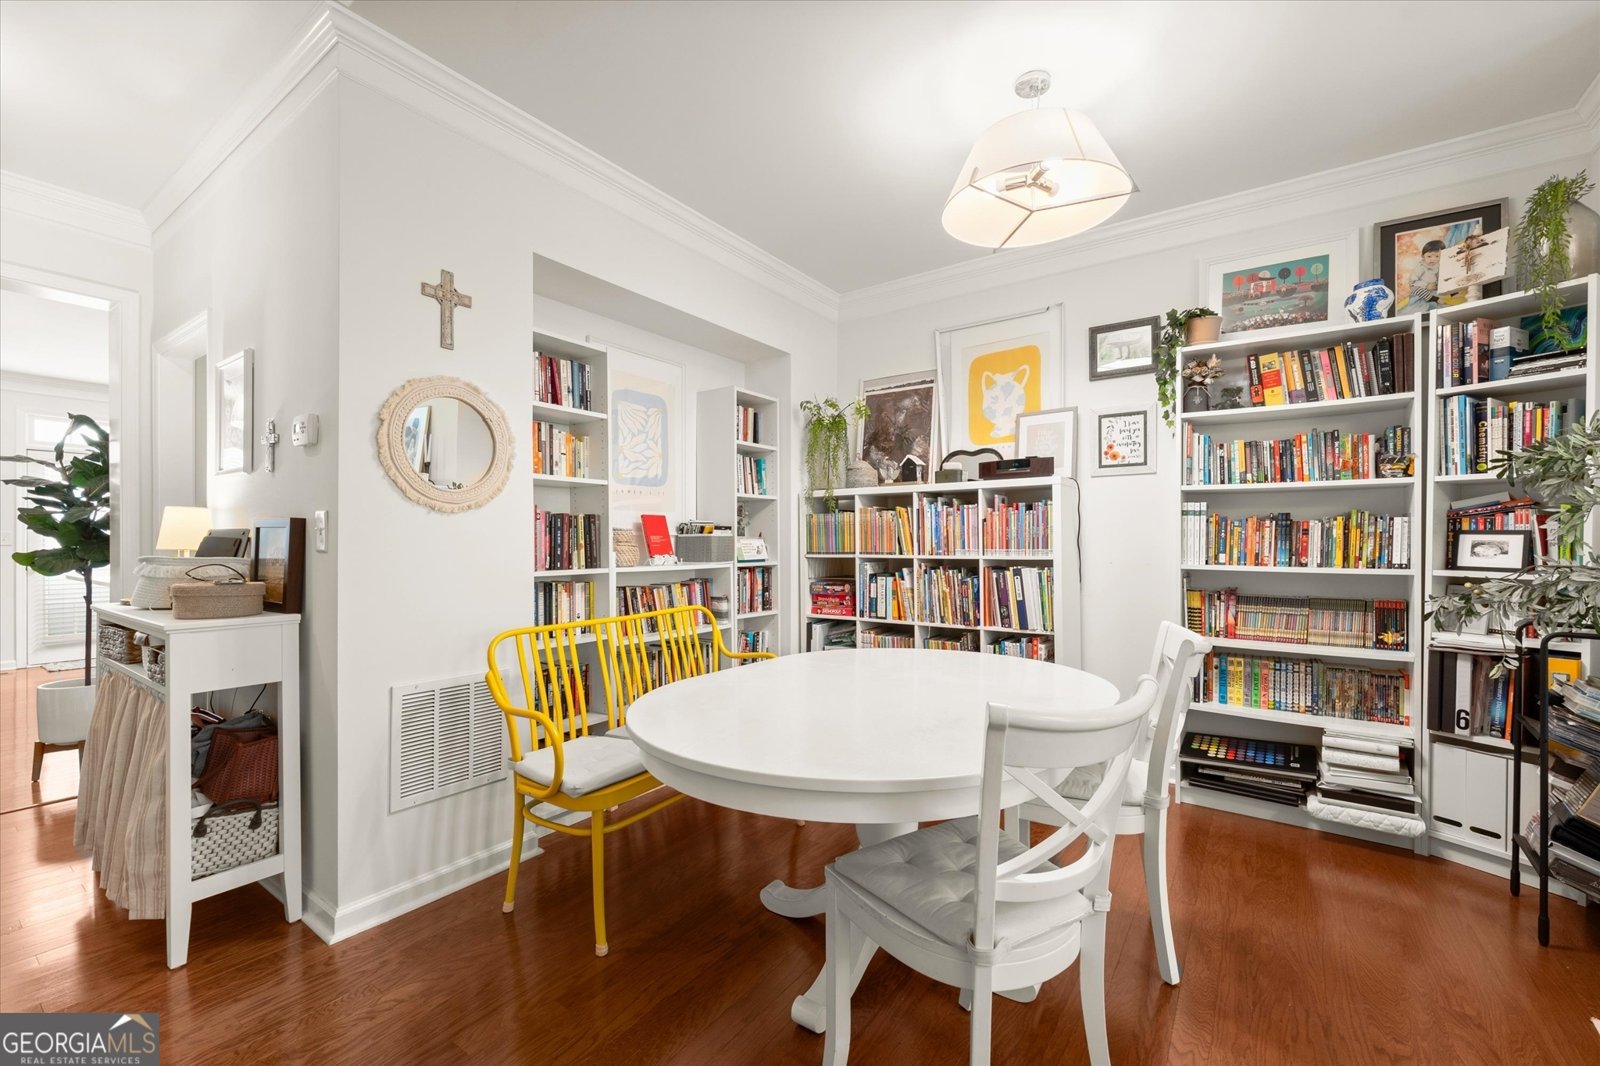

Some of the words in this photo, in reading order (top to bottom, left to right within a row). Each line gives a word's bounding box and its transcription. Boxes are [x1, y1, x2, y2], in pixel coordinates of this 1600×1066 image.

[1451, 358, 1459, 378] COLOR
[1476, 420, 1488, 463] Chemistry
[1456, 709, 1470, 731] 6
[1493, 701, 1503, 724] Dictionary
